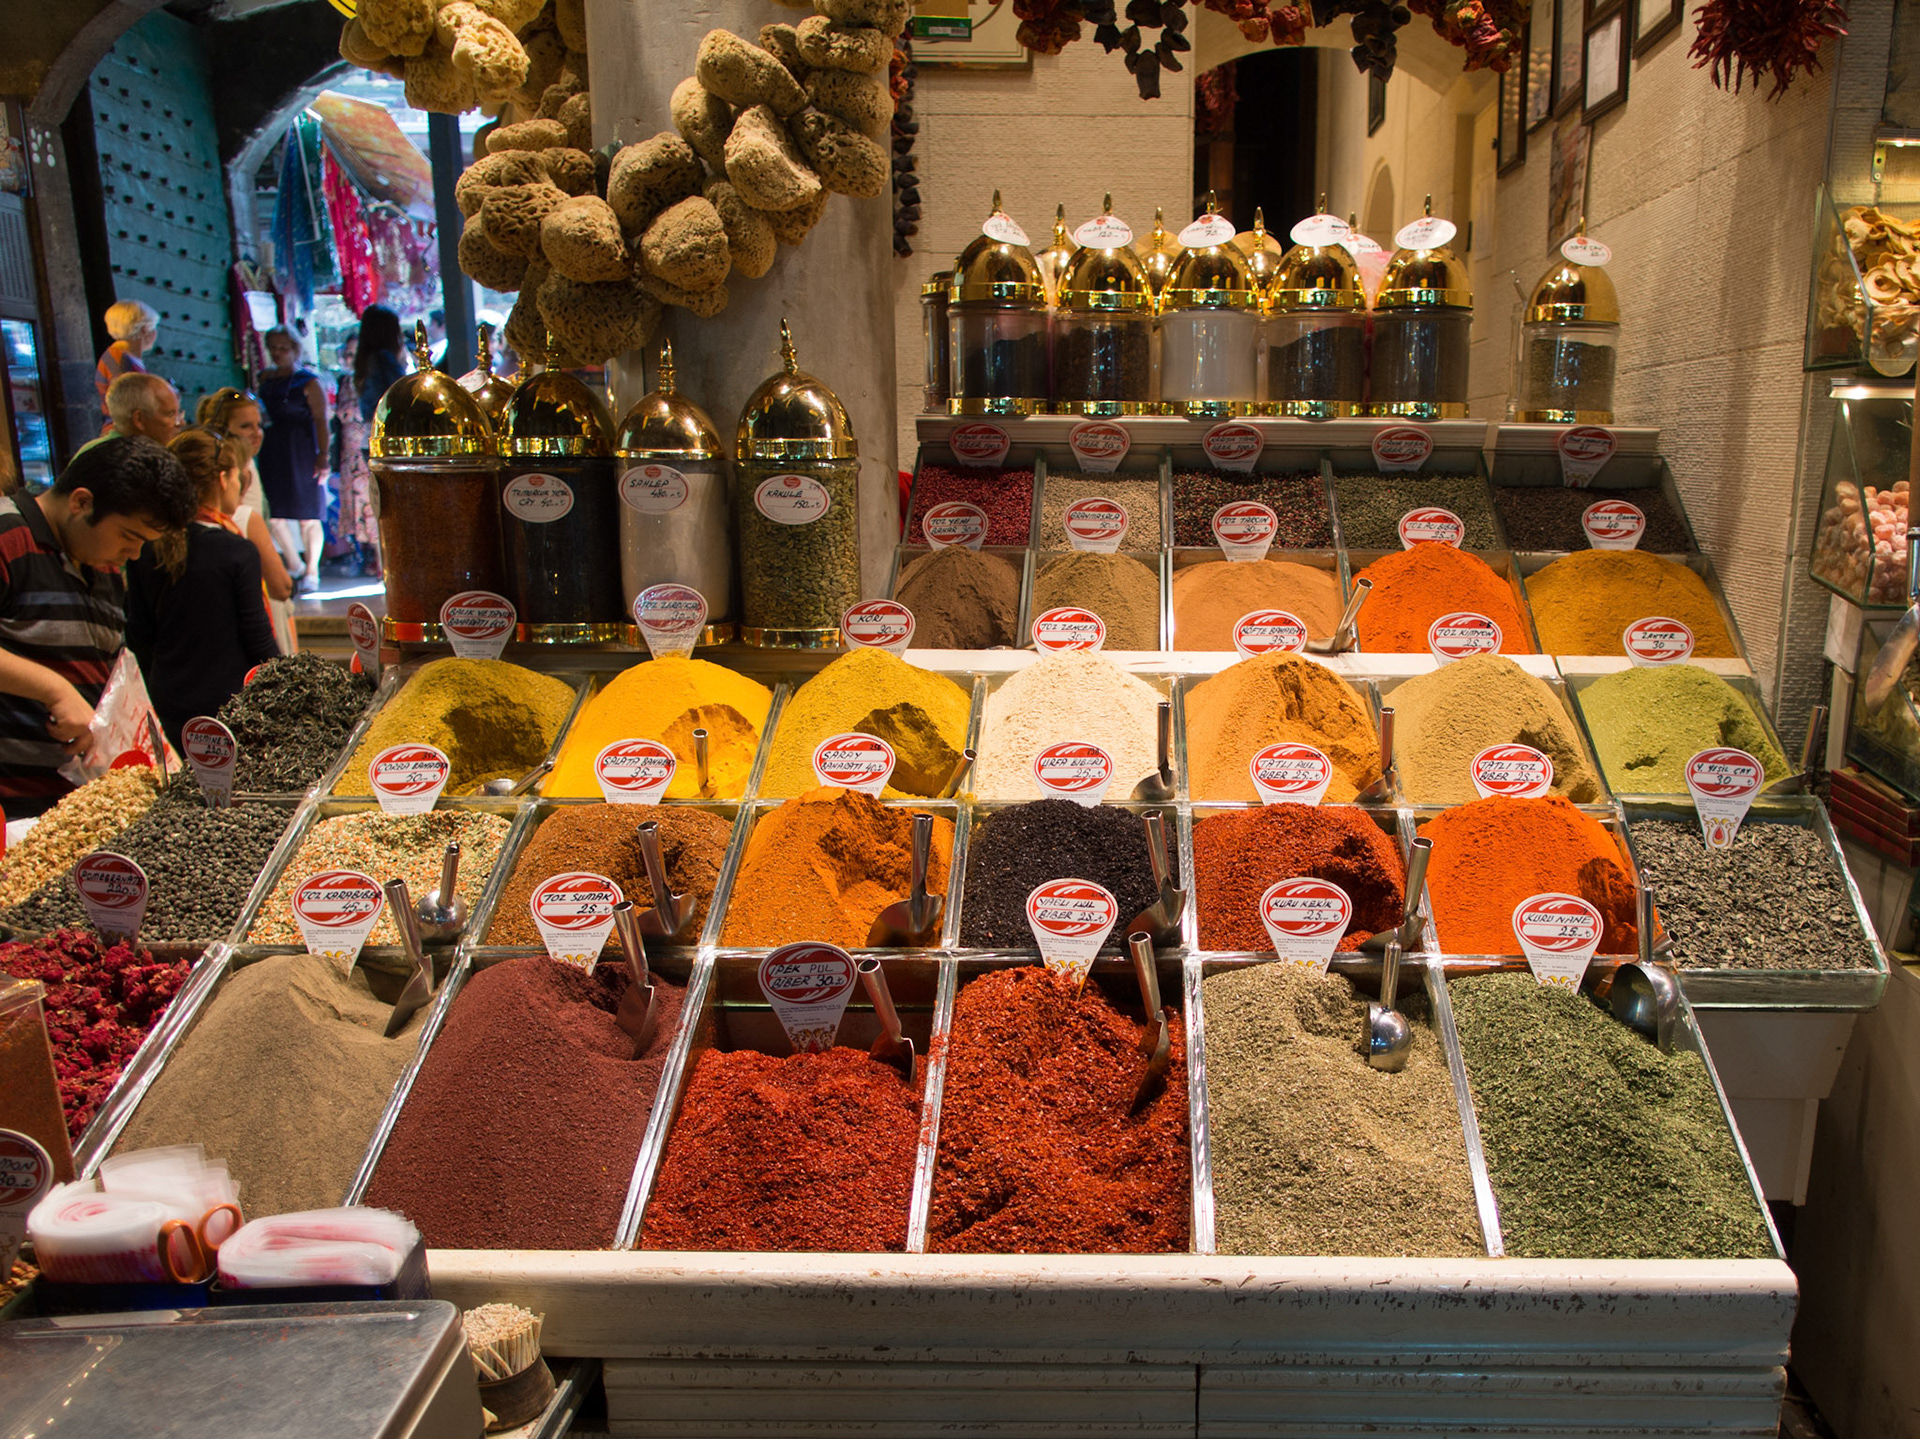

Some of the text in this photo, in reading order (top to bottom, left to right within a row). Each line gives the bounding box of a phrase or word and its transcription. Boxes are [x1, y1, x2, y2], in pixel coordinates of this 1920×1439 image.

[765, 489, 803, 498] KAKULE
[930, 517, 947, 526] TOZ
[1041, 623, 1058, 631] TOZ
[1437, 628, 1457, 636] TOZ
[1652, 640, 1665, 649] 30
[823, 750, 862, 760] SARAY
[603, 756, 640, 766] SALATA
[1041, 757, 1068, 767] URFA
[1259, 758, 1316, 770] TATLI PUL
[1481, 761, 1536, 771] TATLI TOZ
[1714, 774, 1732, 786] 30
[302, 891, 322, 900] TOZ
[543, 892, 613, 903] TOZ SUMAK
[1271, 899, 1299, 908] KURU
[1525, 913, 1591, 924] KURU NANE
[809, 963, 834, 973] PUL
